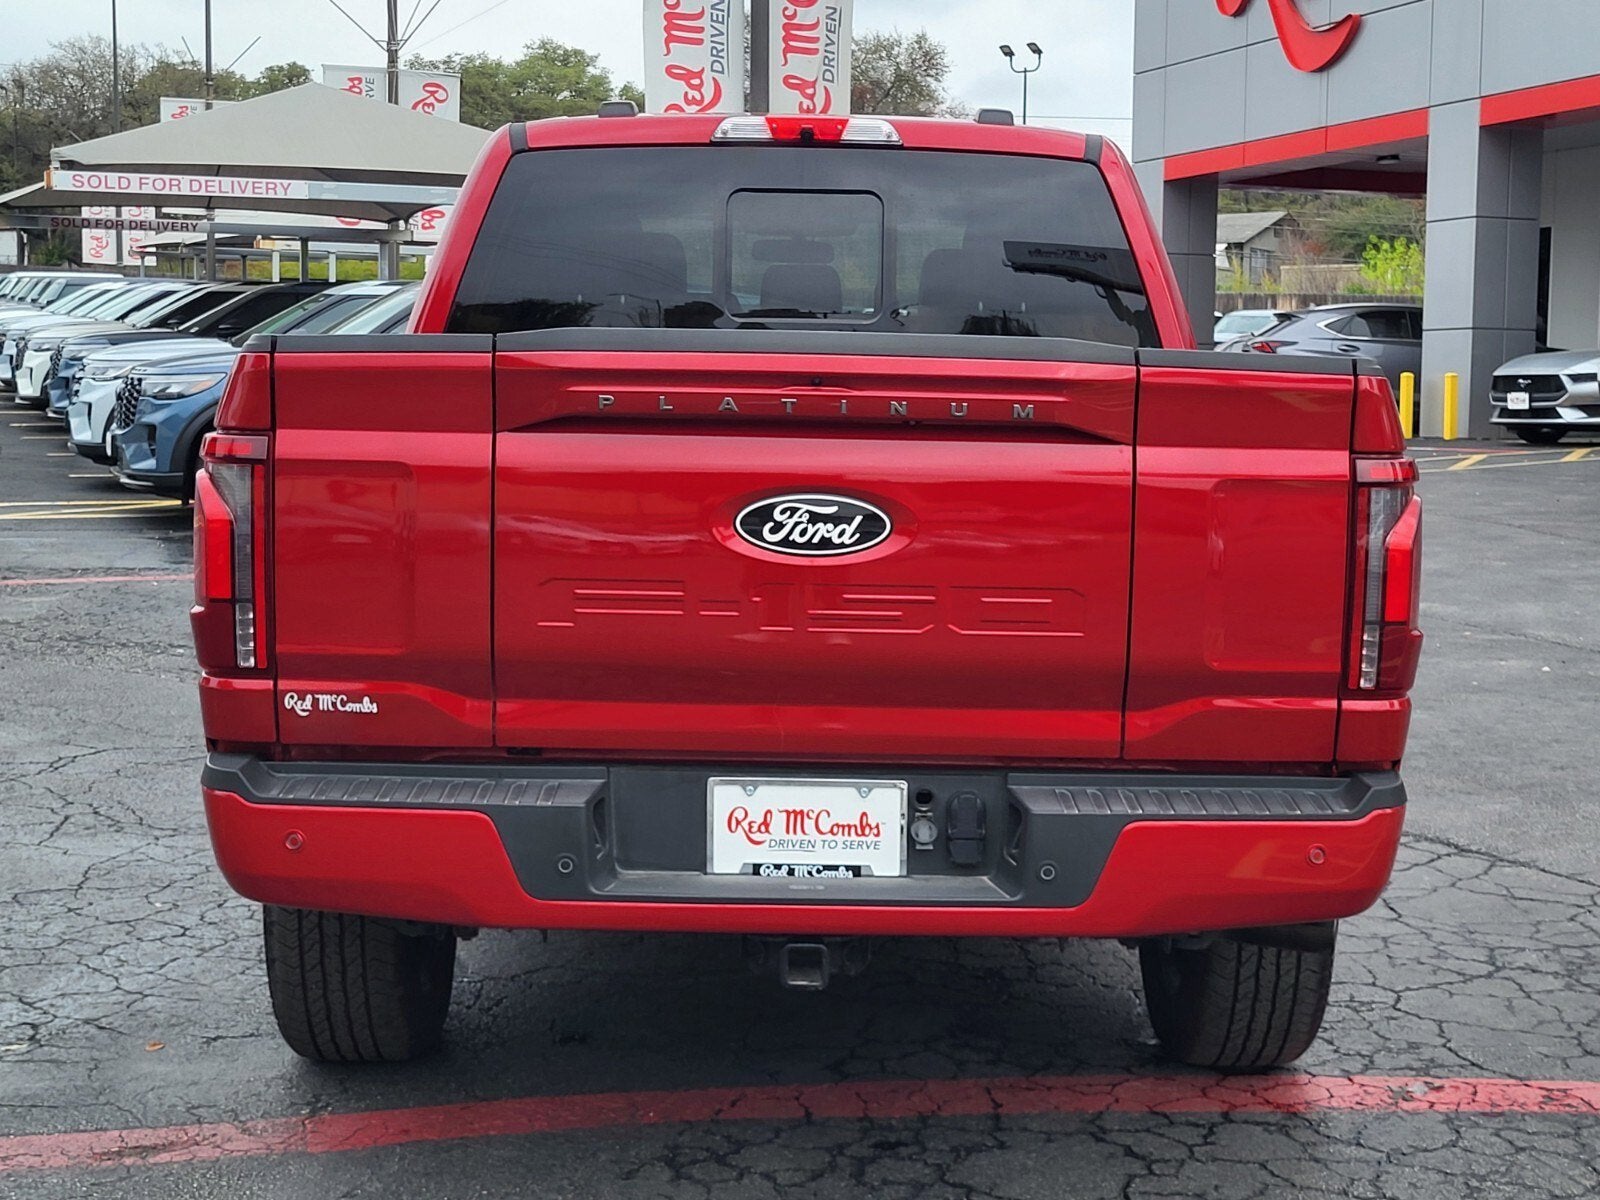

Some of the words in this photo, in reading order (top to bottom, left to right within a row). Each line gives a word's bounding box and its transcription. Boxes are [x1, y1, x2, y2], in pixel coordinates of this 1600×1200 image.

[710, 0, 725, 75] DRIVEN
[822, 6, 838, 84] DRIVEN
[782, 74, 832, 114] ed
[72, 173, 131, 190] SOLD
[138, 176, 182, 193] FOR
[189, 179, 292, 196] DELIVERY
[51, 217, 90, 228] SOLD
[95, 219, 124, 230] FOR
[129, 220, 199, 232] DELIVERY
[598, 394, 1034, 419] PLATINUM
[762, 502, 864, 545] Ford
[284, 692, 312, 717] Red
[314, 694, 378, 713] McCombs
[727, 806, 773, 845] Red
[778, 808, 881, 837] McCombs
[768, 839, 816, 849] DRIVEN
[820, 839, 838, 849] TO
[841, 840, 881, 850] SERVE
[760, 863, 789, 878] Red
[790, 865, 854, 878] McCombs
